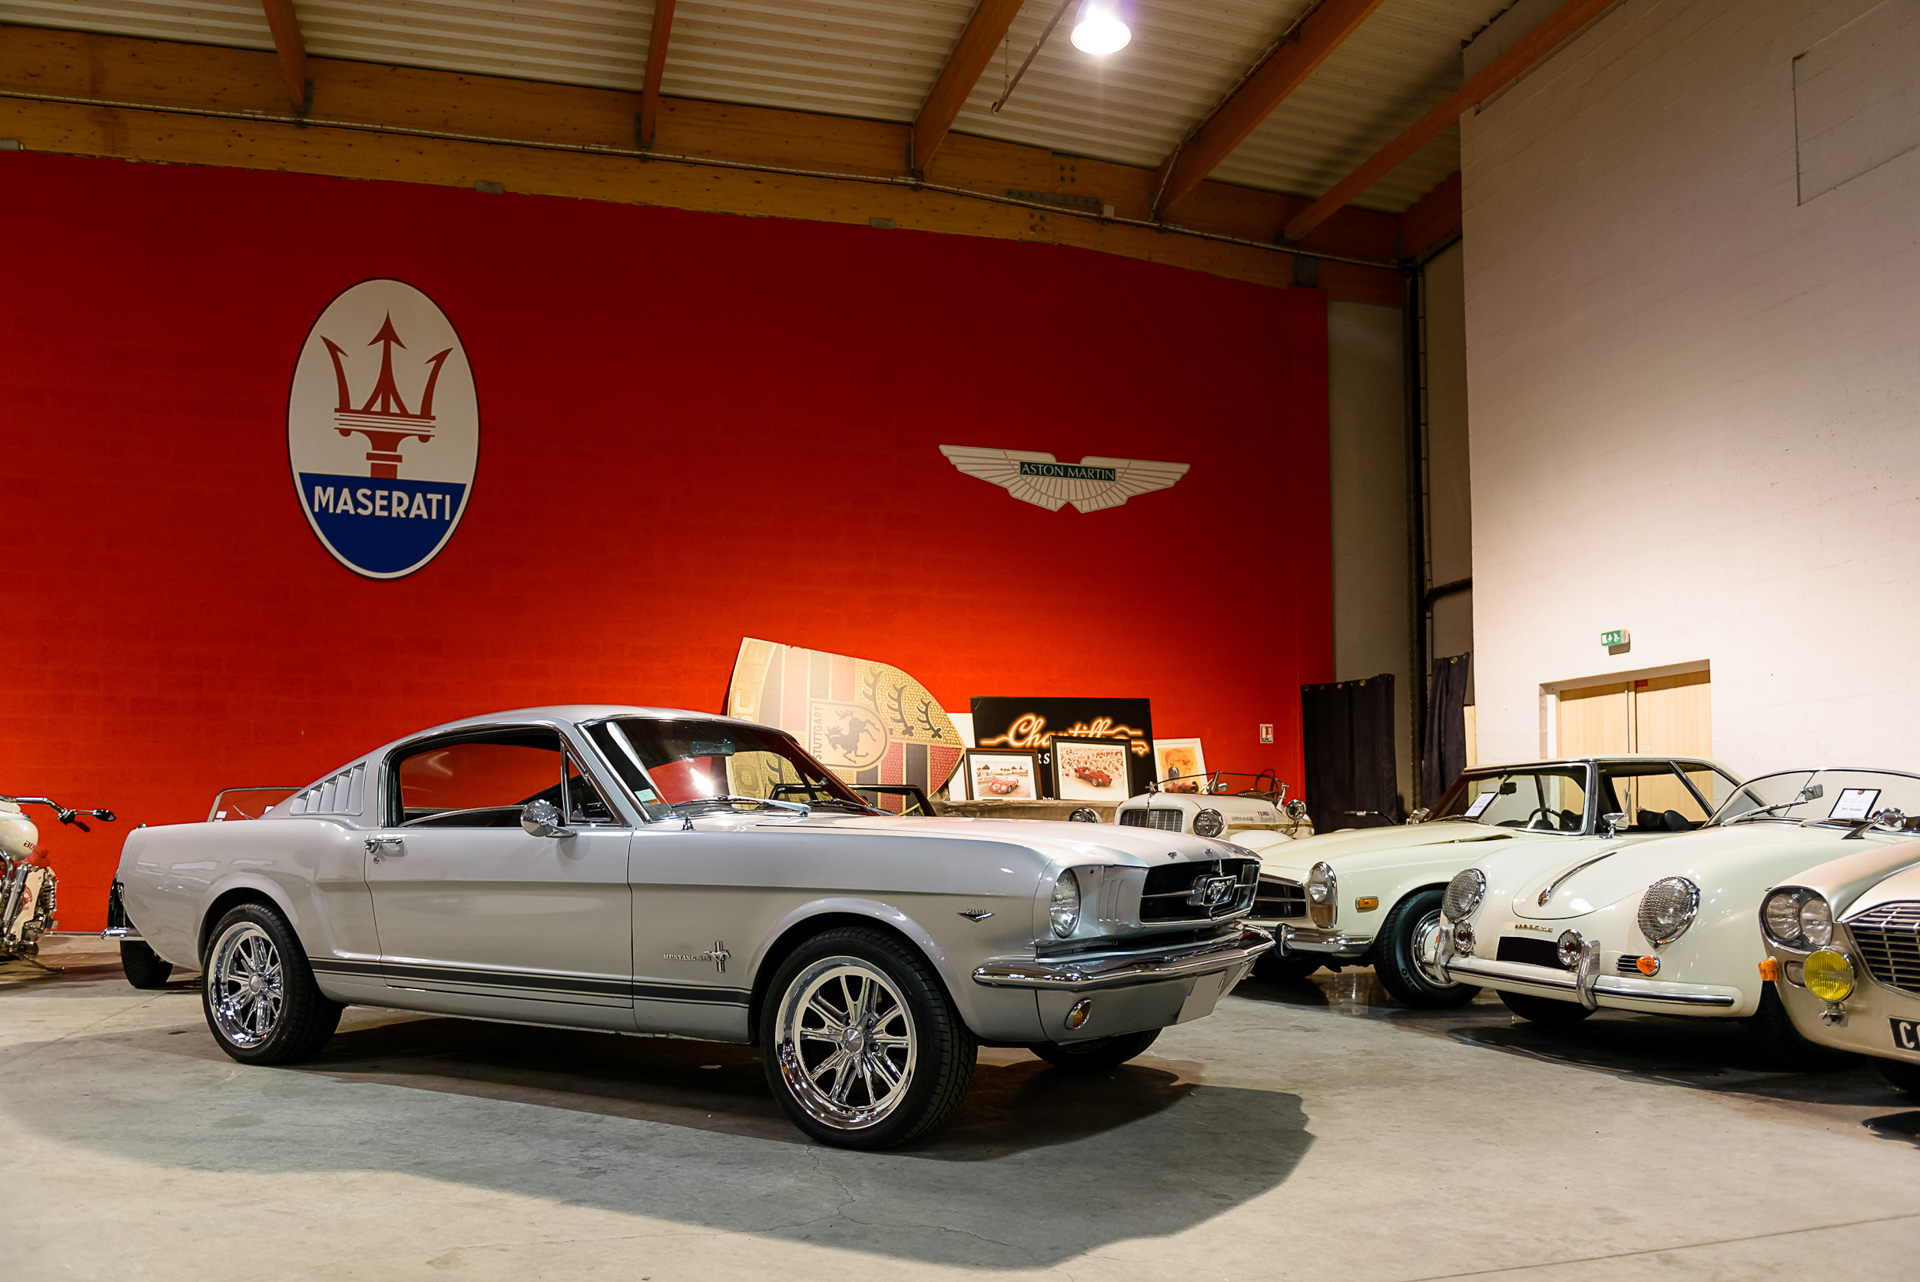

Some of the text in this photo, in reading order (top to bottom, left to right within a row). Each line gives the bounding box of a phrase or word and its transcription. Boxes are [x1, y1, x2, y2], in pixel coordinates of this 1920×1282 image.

[1021, 463, 1115, 481] ASTON MARTIN
[313, 485, 451, 521] MASERATI
[813, 705, 823, 761] STUTTGART
